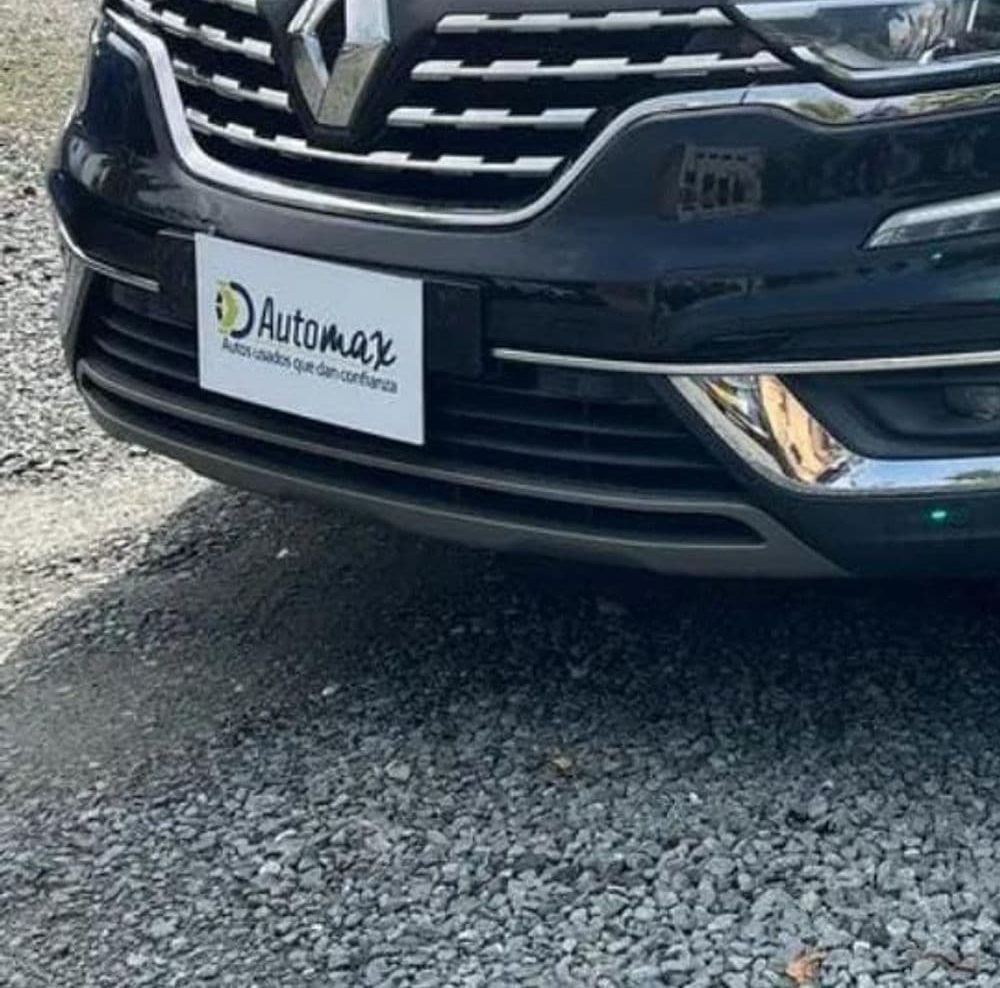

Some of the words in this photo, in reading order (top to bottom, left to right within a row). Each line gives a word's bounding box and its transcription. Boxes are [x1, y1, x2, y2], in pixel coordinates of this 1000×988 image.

[222, 337, 251, 358] Autos
[293, 358, 314, 375] que
[341, 368, 398, 394] confianza
[258, 296, 397, 371] Automax
